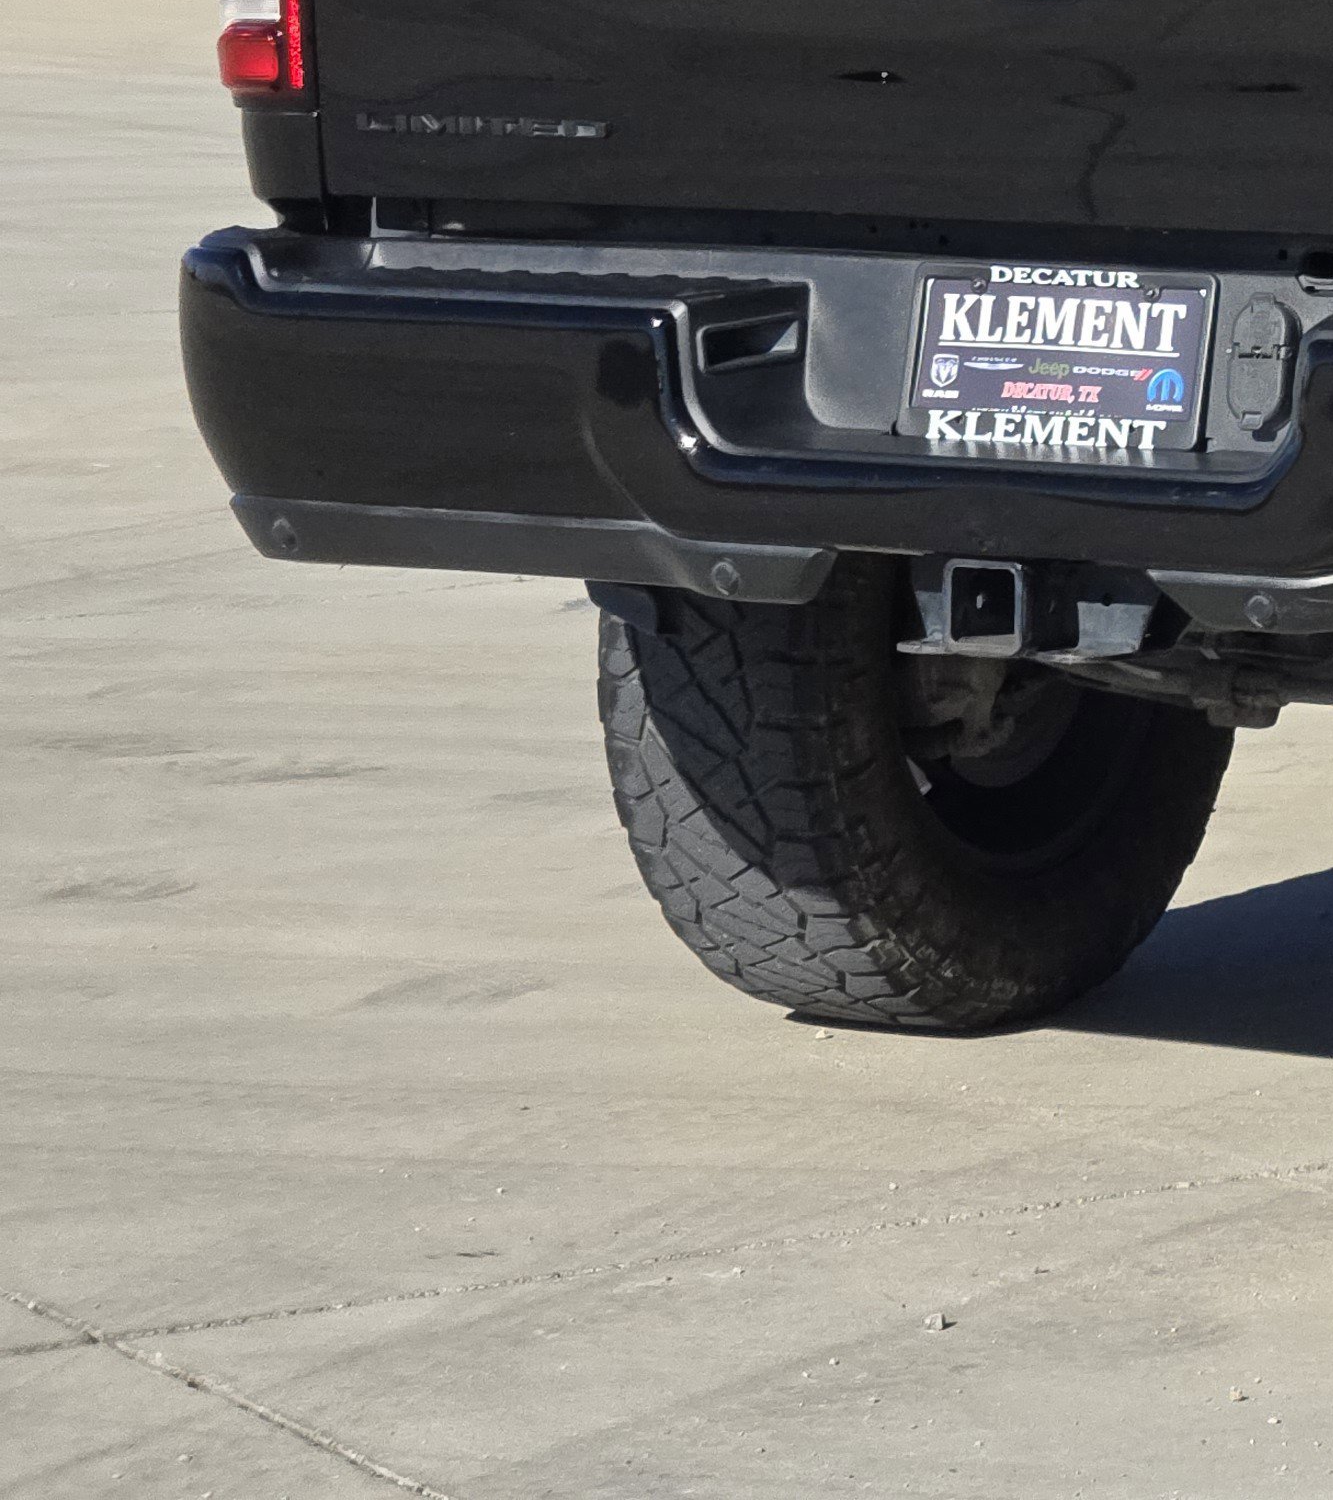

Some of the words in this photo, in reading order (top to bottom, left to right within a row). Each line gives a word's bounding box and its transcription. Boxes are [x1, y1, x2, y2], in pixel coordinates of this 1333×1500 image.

[989, 265, 1140, 289] DECATUR
[940, 293, 1187, 351] KLEMENT
[1028, 358, 1070, 379] Jeep
[1072, 366, 1139, 377] DODGE
[1001, 381, 1075, 404] DECATUR,
[1078, 385, 1103, 403] TX
[925, 409, 1167, 450] KLEMENT
